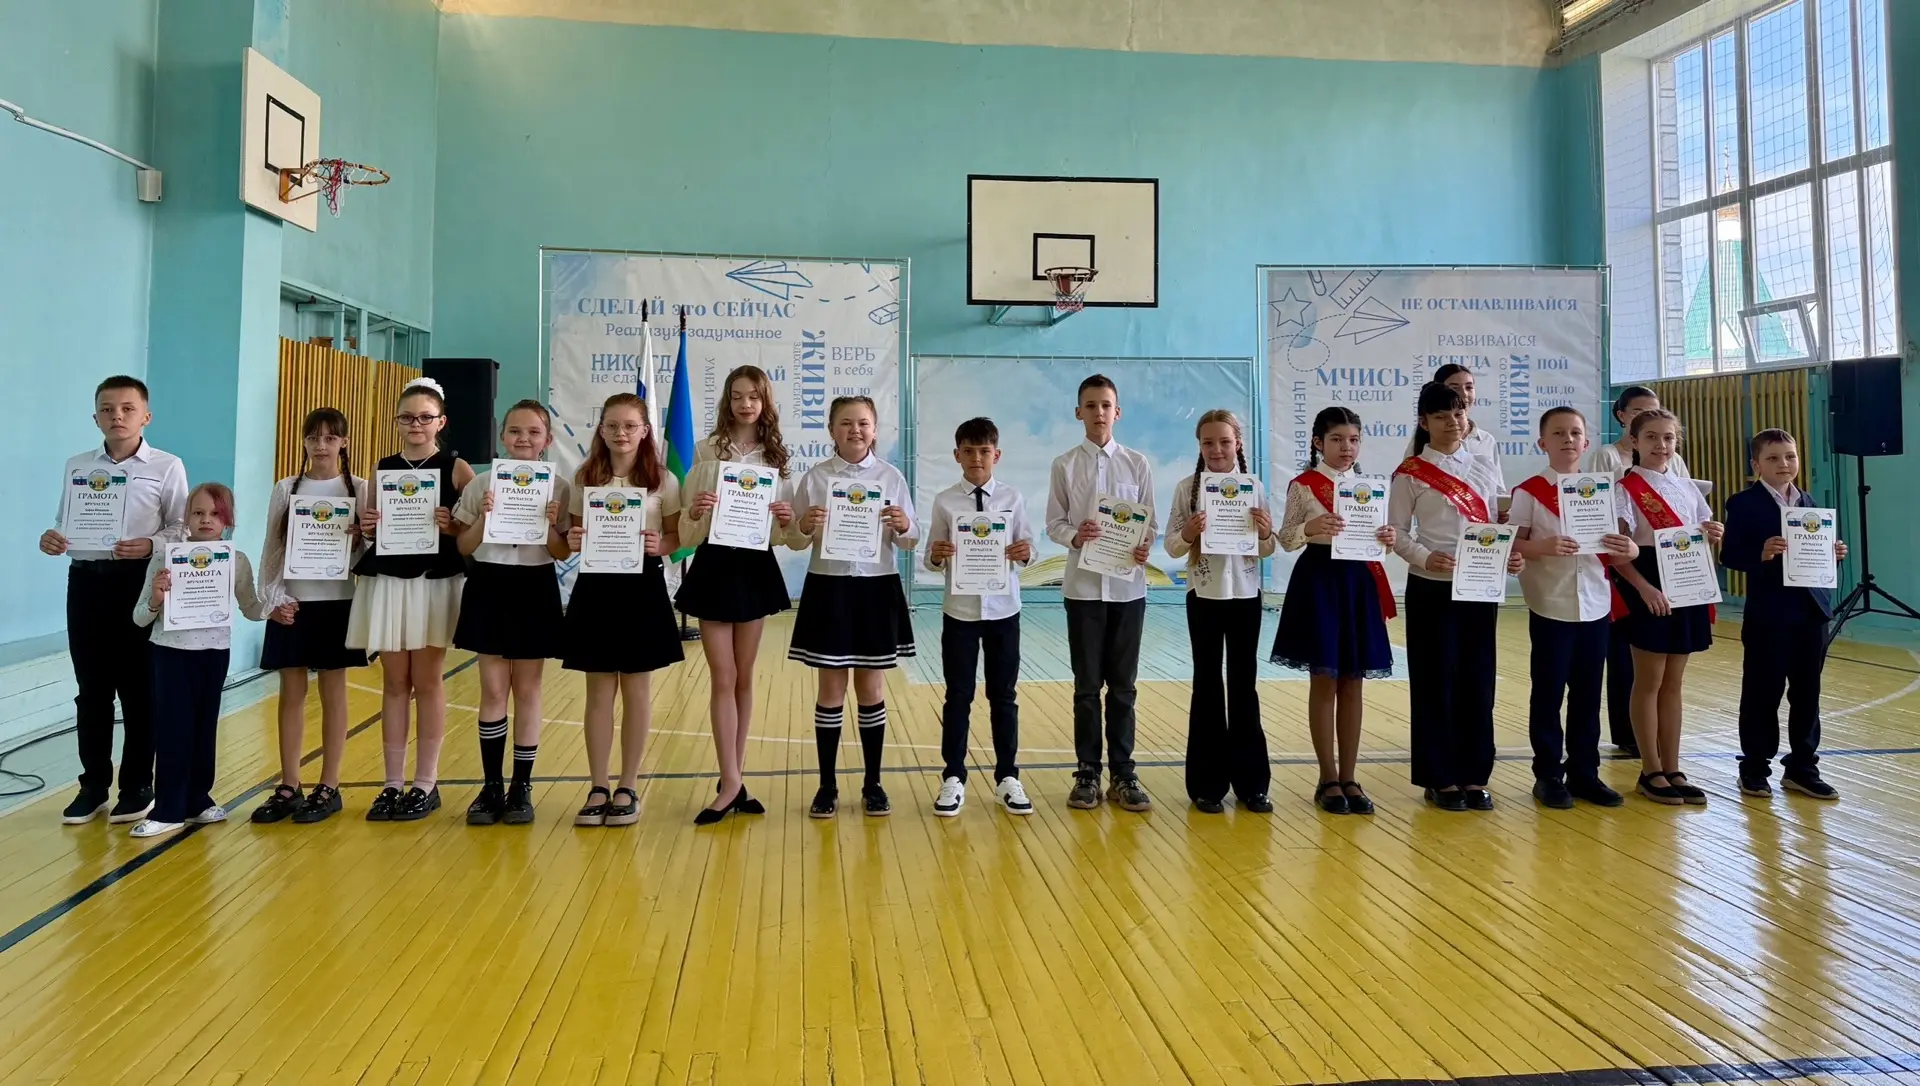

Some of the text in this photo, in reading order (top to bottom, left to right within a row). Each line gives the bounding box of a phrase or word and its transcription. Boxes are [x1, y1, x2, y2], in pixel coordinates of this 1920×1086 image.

[713, 298, 796, 318] СЕЙЧАС
[1401, 296, 1577, 310] НЕ ОСТАНАВЛИВАЙСЯ
[688, 328, 782, 342] задуманное
[1438, 333, 1536, 346] РАЗВИВАЙСЯ
[832, 346, 876, 361] ВЕРЬ
[1428, 355, 1491, 369] ВСЕГДА
[1537, 356, 1568, 370] ПОЙ
[834, 364, 874, 376] в себя
[1412, 354, 1424, 392] УМЕЙ
[591, 374, 608, 383] не
[802, 329, 826, 430] ЖИВИ
[1316, 368, 1409, 387] МЧИСЬ
[704, 356, 716, 435] УМЕЙ ПРОЩ
[1332, 390, 1393, 402] к цели
[1510, 354, 1530, 436] ЖИВИ
[1292, 381, 1306, 476] ЦЕНИ ВРЕМ
[78, 492, 118, 500] ГРАМОТА
[501, 486, 542, 496] ГРАМОТА
[727, 489, 764, 500] ГРАМОТА
[388, 497, 428, 505] ГРАМОТА
[1211, 499, 1248, 507] ГРАМОТА
[1569, 499, 1605, 507] ГРАМОТА
[836, 504, 874, 514] ГРАМОТА
[1344, 504, 1379, 513] ГРАМОТА
[301, 522, 342, 530] ГРАМОТА
[1100, 520, 1136, 535] ГРАМОТА
[1794, 533, 1829, 541] ГРАМОТА
[1466, 546, 1500, 555] ГРАМОТА
[1666, 550, 1701, 561] ГРАМОТА
[178, 569, 222, 578] ГРАМОТА
